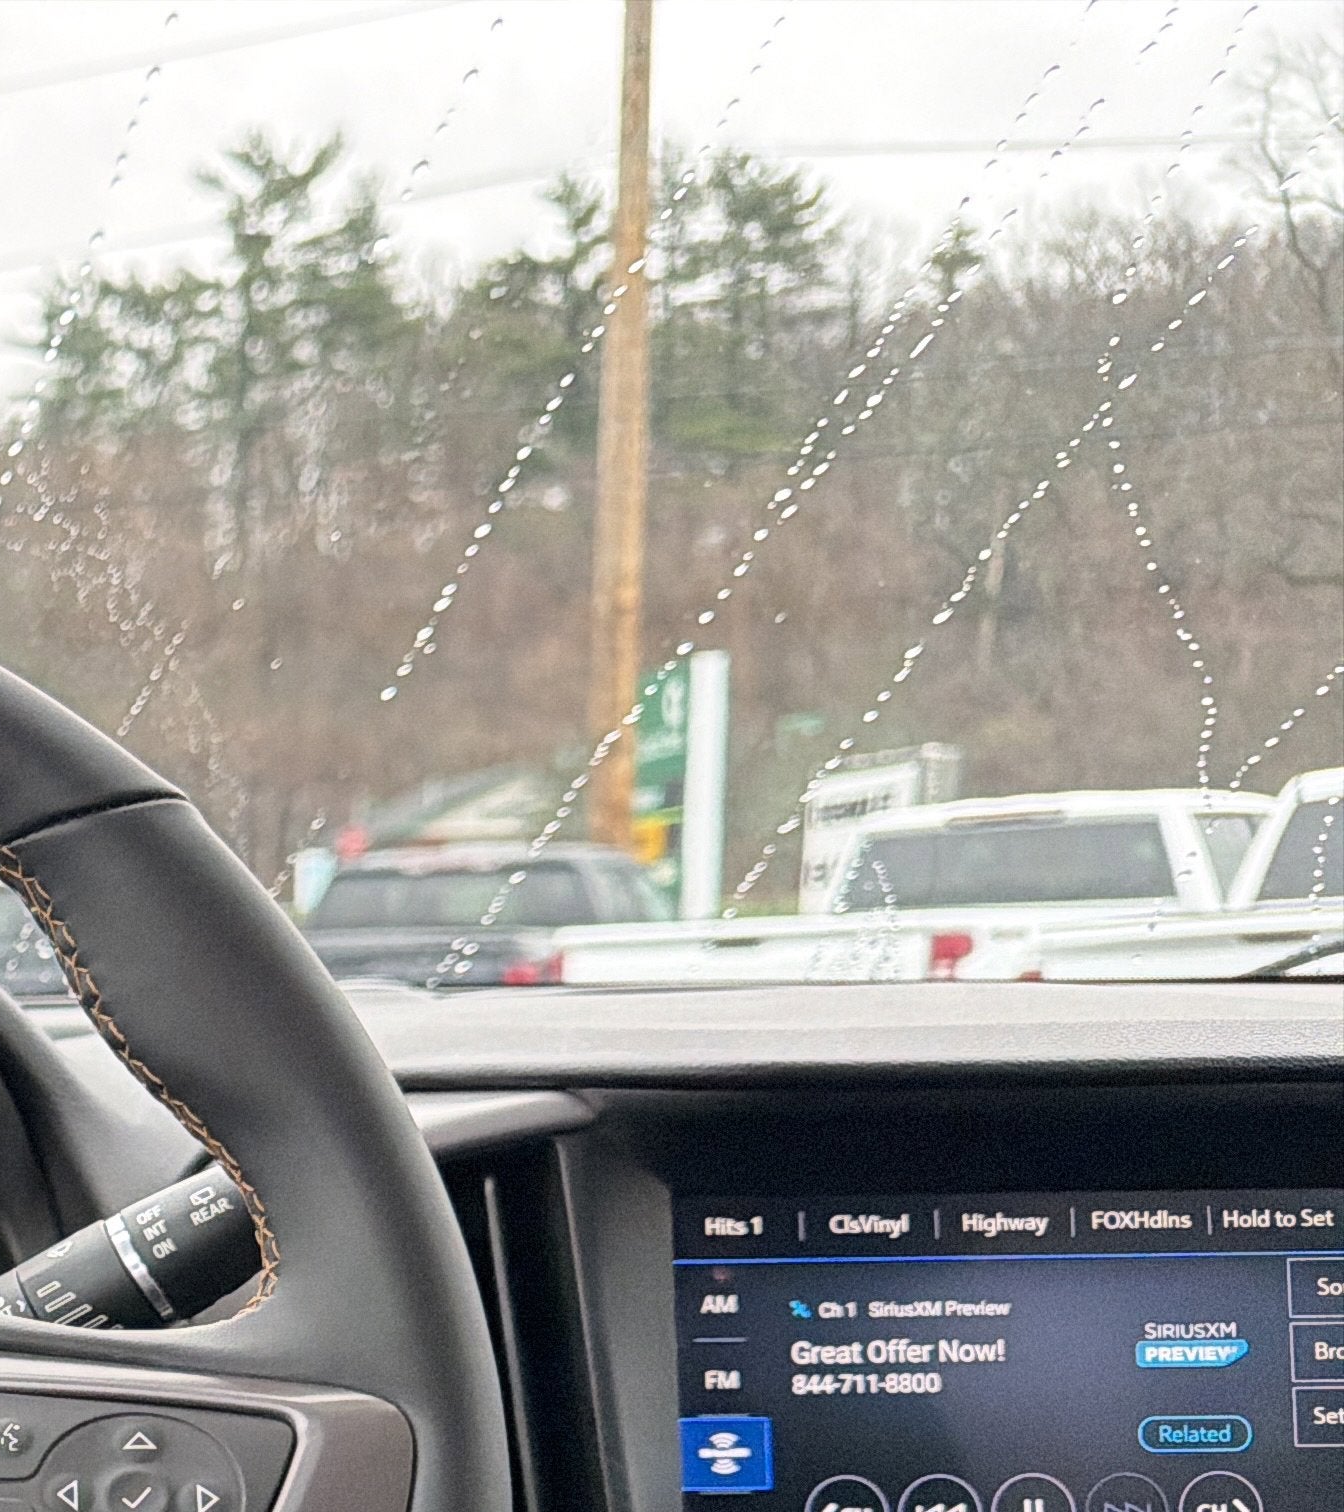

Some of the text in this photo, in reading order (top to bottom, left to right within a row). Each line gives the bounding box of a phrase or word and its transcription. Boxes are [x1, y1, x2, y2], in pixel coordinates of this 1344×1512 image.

[135, 1204, 161, 1225] OFF
[190, 1197, 234, 1226] REAR
[1090, 1209, 1193, 1231] FOXHdlns
[1221, 1208, 1335, 1229] Hold to Set
[142, 1219, 167, 1241] INT
[704, 1215, 764, 1236] Hits 1
[961, 1212, 1050, 1238] Highway
[152, 1238, 178, 1259] ON
[1316, 1277, 1344, 1297] So
[699, 1294, 739, 1315] AM
[817, 1300, 1011, 1319] Ch 1 SiriusXM Preview
[1143, 1322, 1238, 1340] SIRIUSXM
[790, 1337, 1006, 1366] Great Offer Now!
[704, 1368, 742, 1391] FM
[791, 1372, 942, 1395] 844-711-8800
[1158, 1424, 1232, 1443] Related
